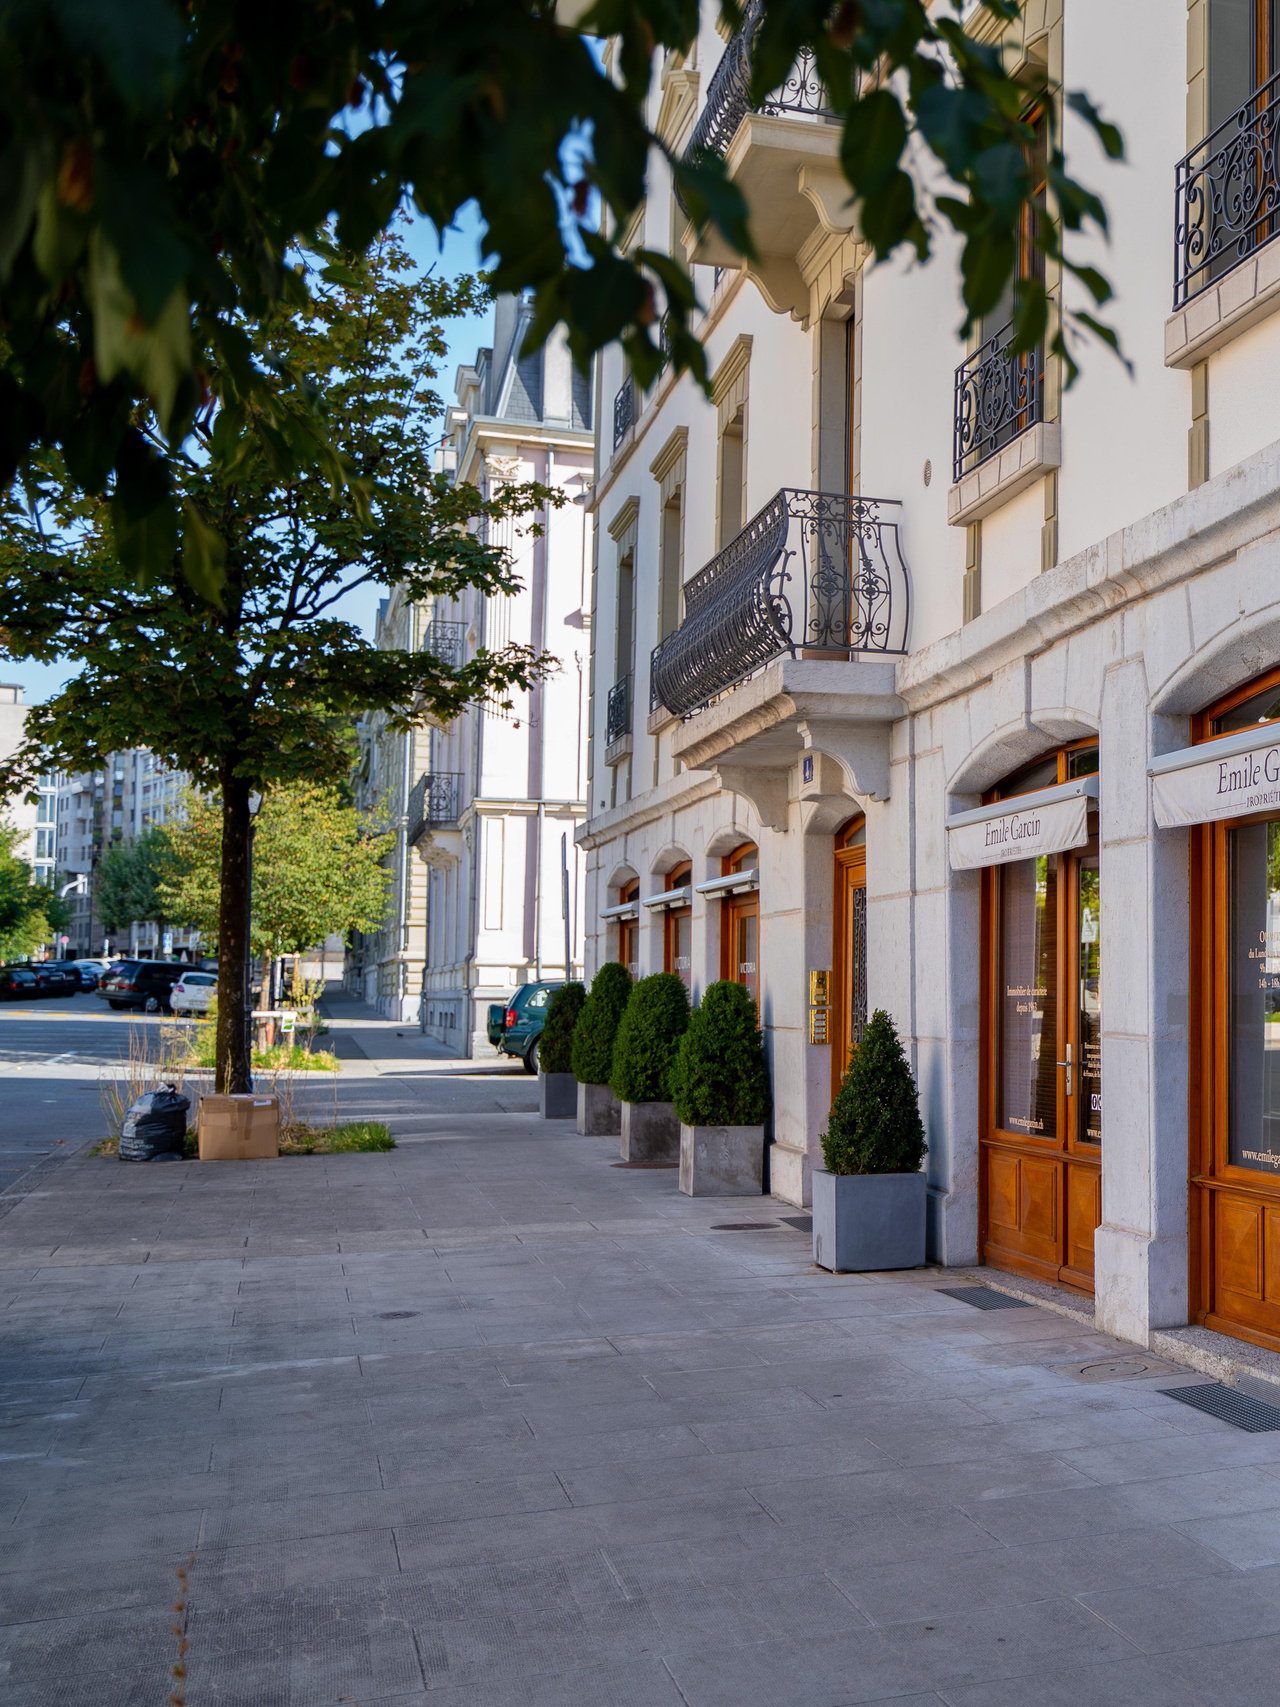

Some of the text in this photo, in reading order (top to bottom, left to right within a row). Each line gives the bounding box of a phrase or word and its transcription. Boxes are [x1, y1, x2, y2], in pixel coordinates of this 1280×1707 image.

[1216, 753, 1261, 795] Emile
[984, 812, 1041, 847] Emile Garcin
